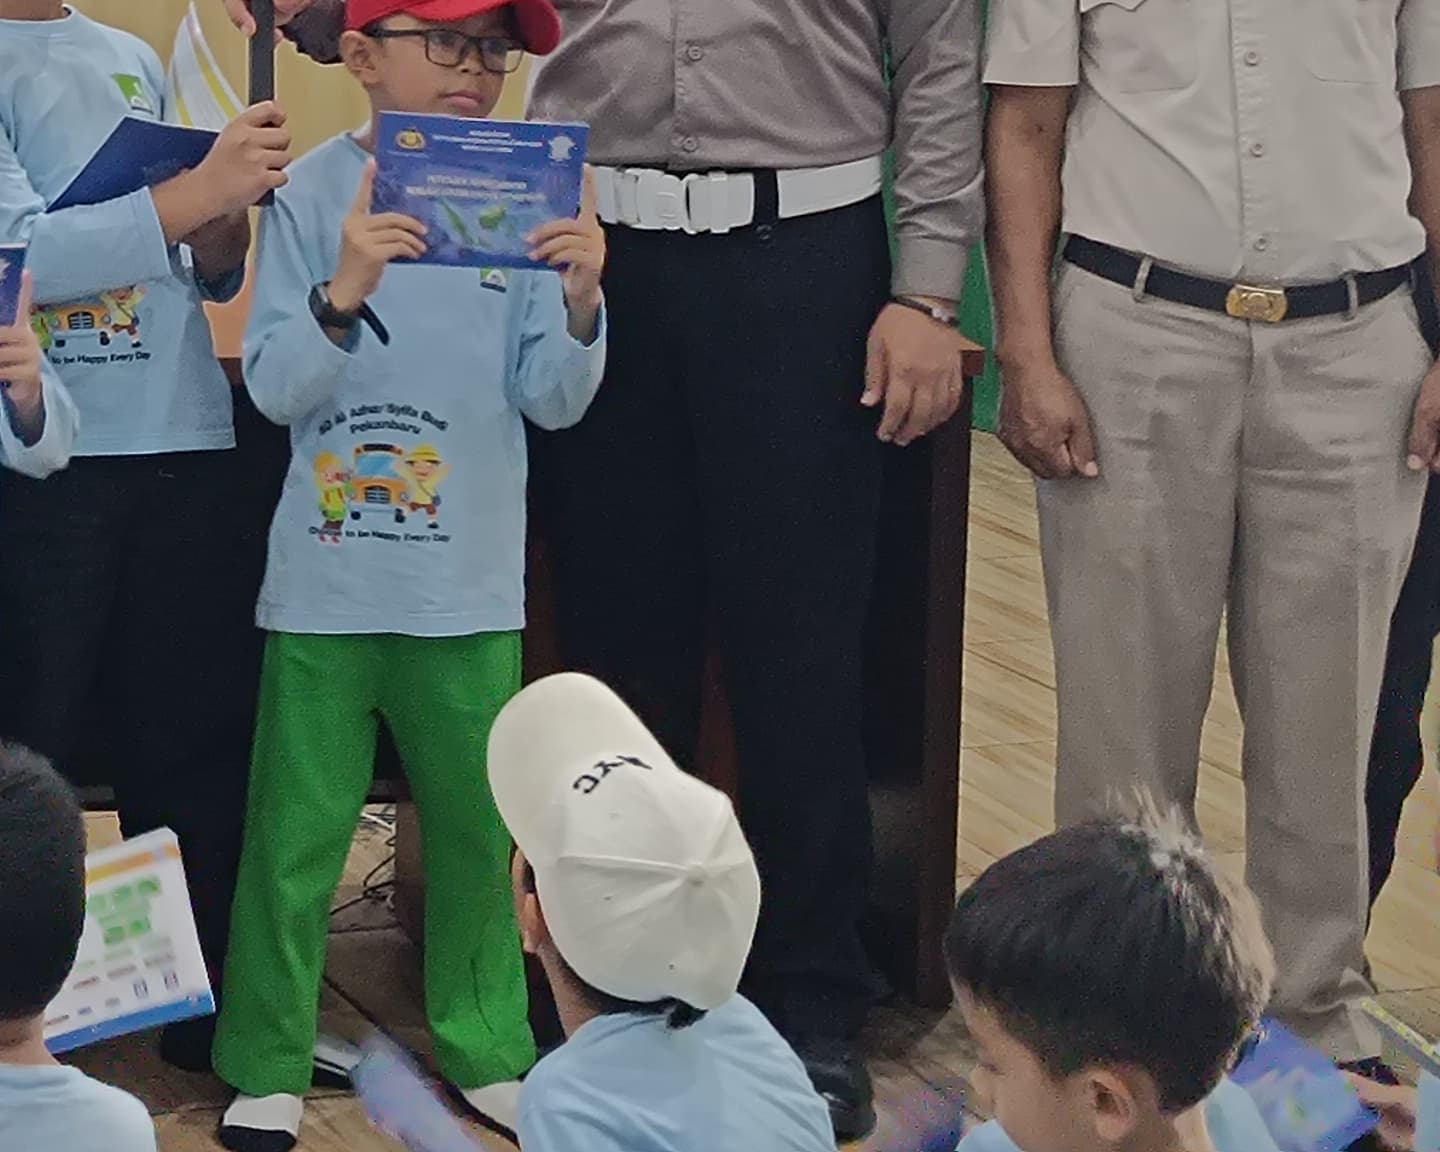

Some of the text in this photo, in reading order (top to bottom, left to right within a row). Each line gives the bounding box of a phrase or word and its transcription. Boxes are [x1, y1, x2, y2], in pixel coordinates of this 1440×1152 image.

[77, 354, 108, 364] Happy
[110, 353, 134, 362] Every
[135, 351, 151, 360] Day
[349, 419, 422, 435] Pekanbaru
